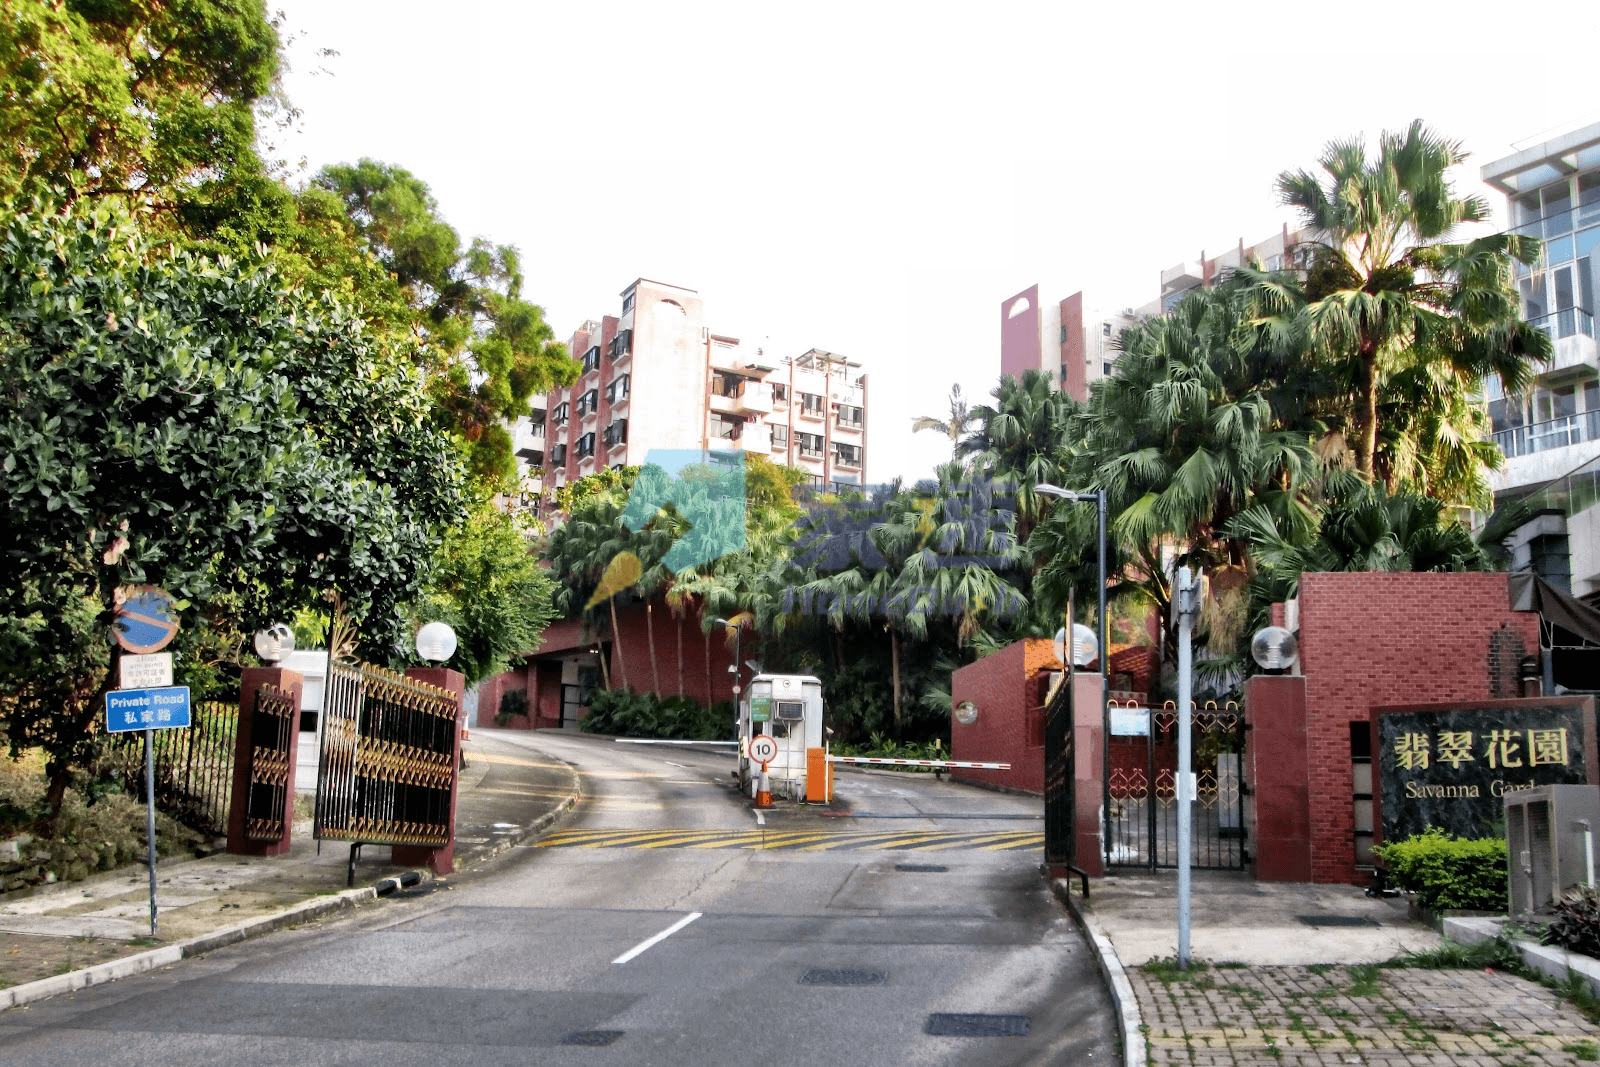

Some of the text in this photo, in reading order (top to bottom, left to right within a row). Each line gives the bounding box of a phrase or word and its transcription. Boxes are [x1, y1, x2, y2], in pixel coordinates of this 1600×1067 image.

[110, 693, 184, 708] Private Road
[124, 708, 171, 724] 私家路
[756, 744, 770, 755] 10
[1394, 727, 1568, 770] 翡翠花園
[1405, 779, 1545, 799] Savanna Gard
